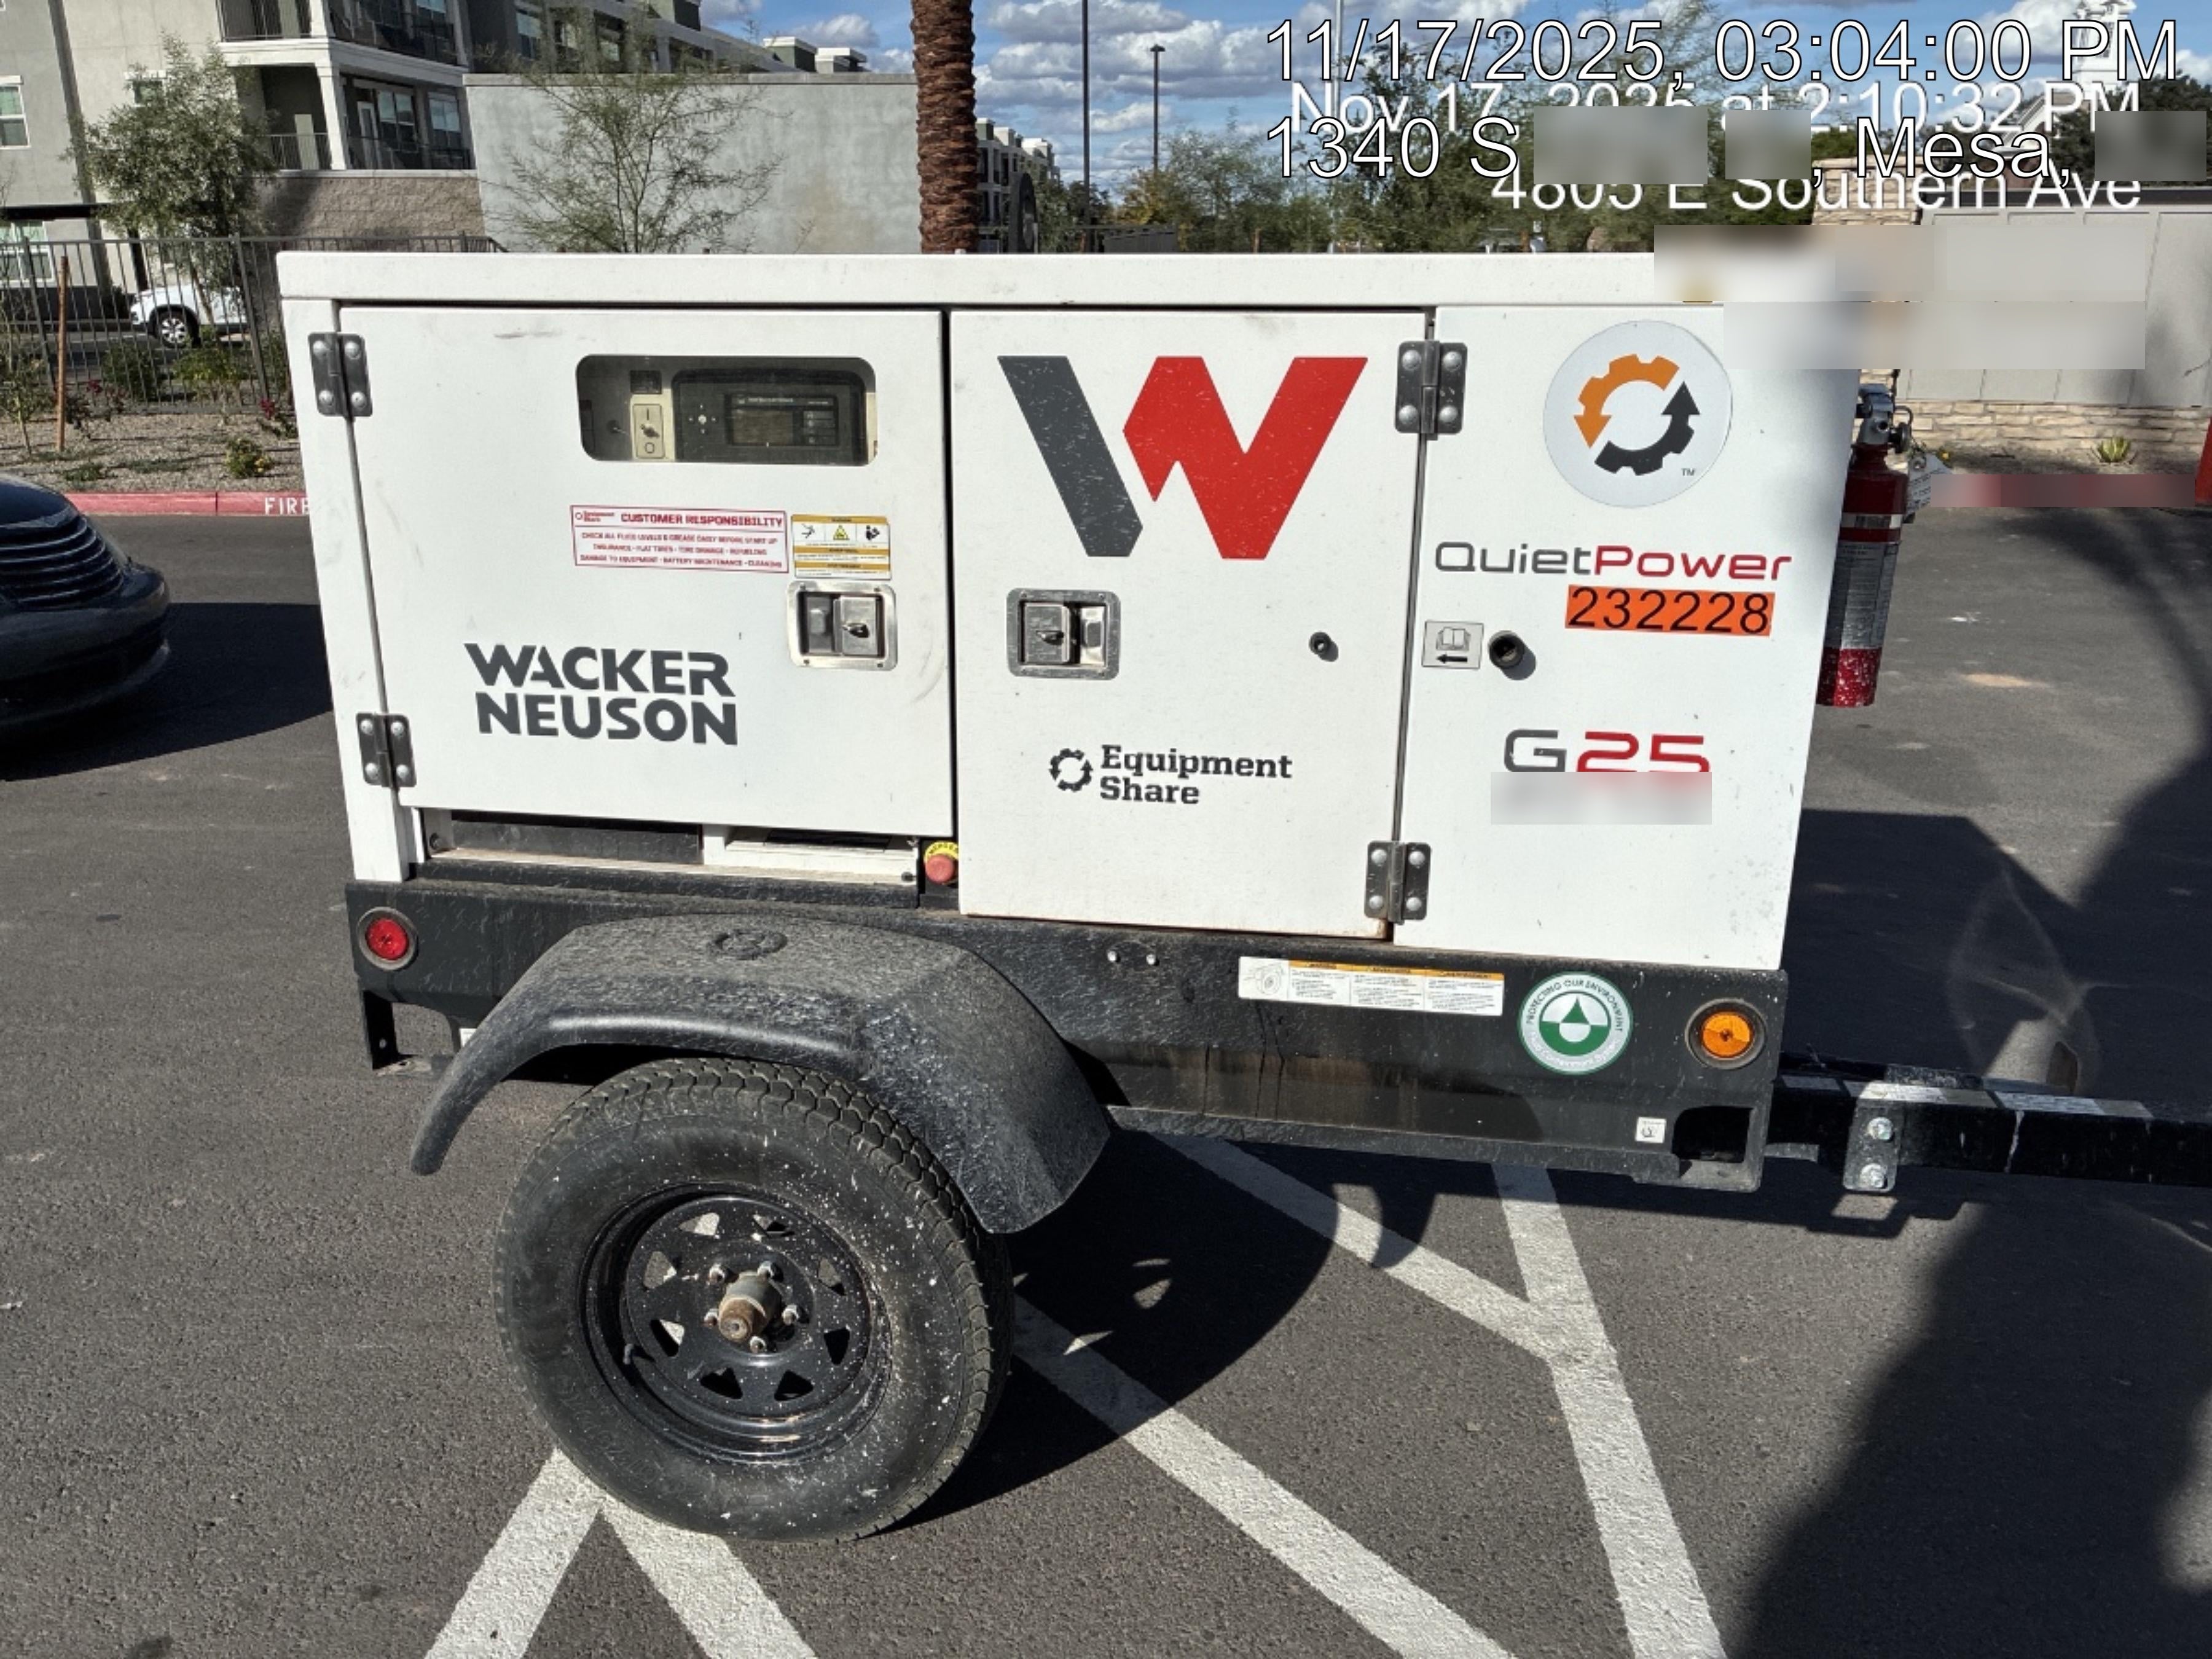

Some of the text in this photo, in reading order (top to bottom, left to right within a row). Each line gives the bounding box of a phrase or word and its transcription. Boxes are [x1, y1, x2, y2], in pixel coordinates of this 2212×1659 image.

[621, 513, 783, 527] CUSTOMER RESPONSIBILITY
[1435, 542, 1792, 581] QuietPower
[1569, 587, 1770, 634] 232228
[464, 643, 736, 697] WACKER
[476, 691, 738, 745] NEUSON
[1100, 744, 1292, 779] Equipment
[1504, 729, 1710, 772] G25
[1100, 775, 1199, 804] Share
